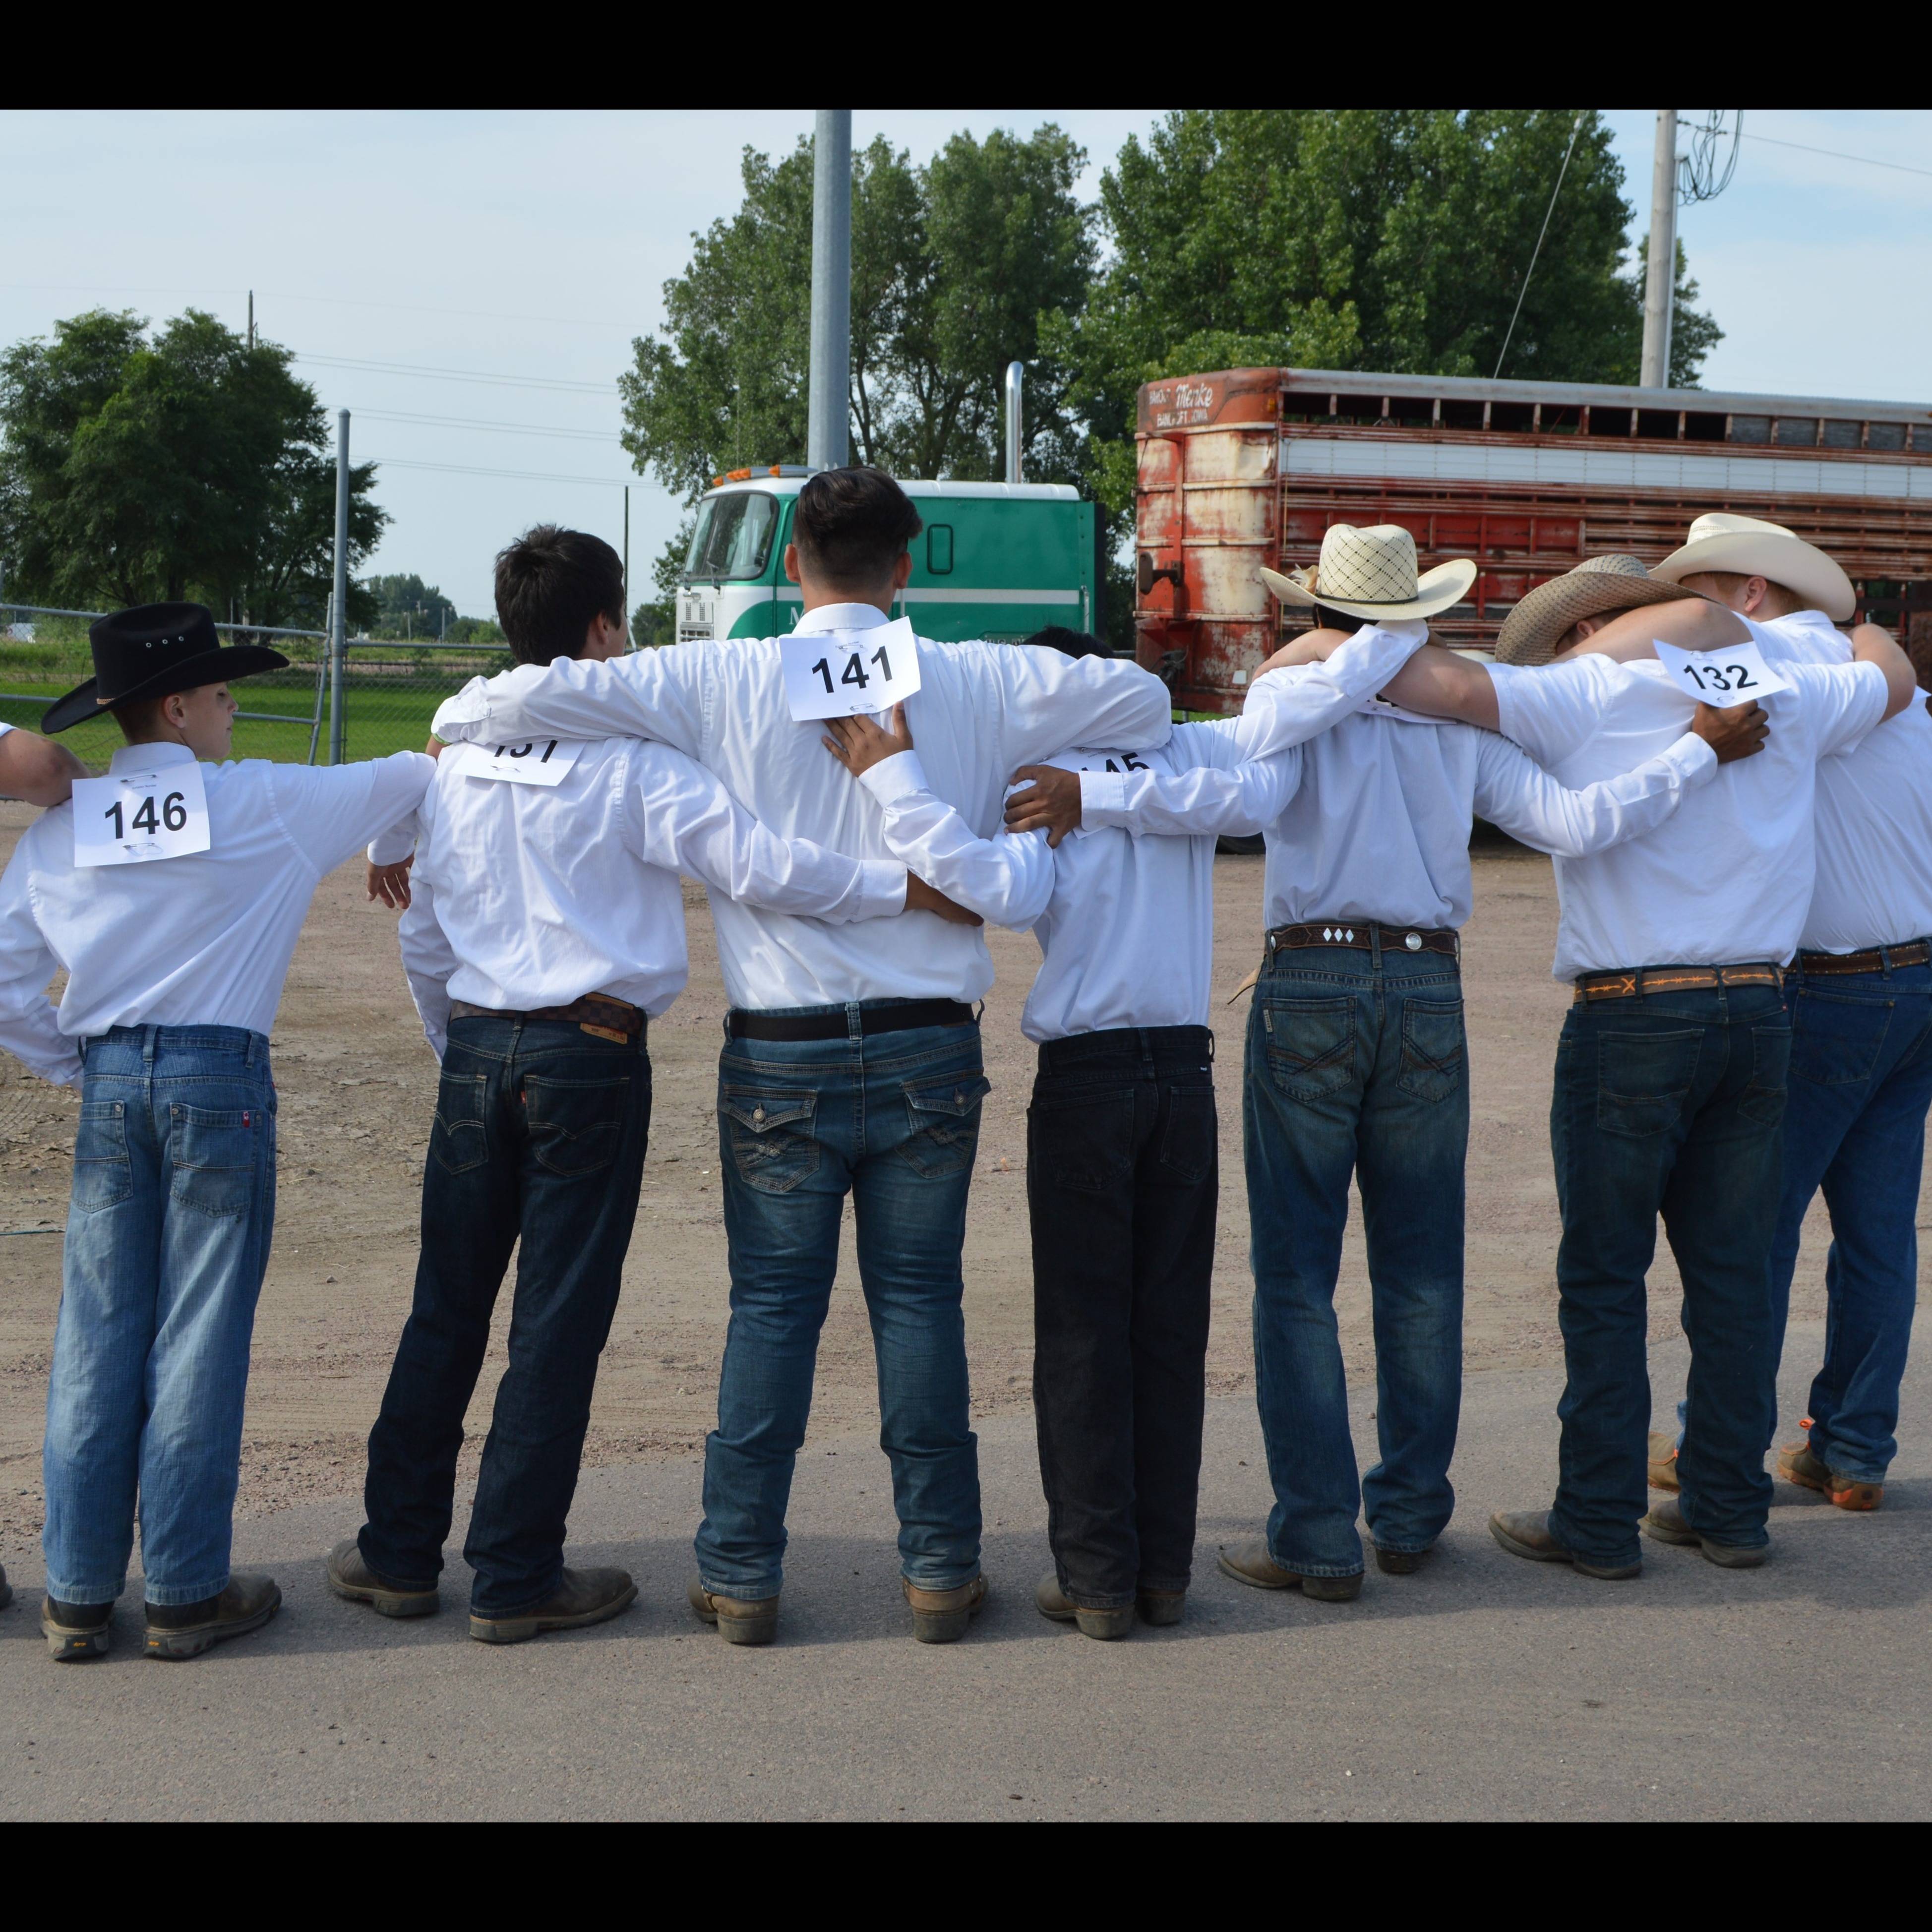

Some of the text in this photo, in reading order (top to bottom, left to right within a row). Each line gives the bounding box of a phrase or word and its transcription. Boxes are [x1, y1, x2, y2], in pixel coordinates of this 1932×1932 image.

[812, 646, 893, 693] 141
[1683, 664, 1758, 691] 132
[105, 791, 187, 839] 146
